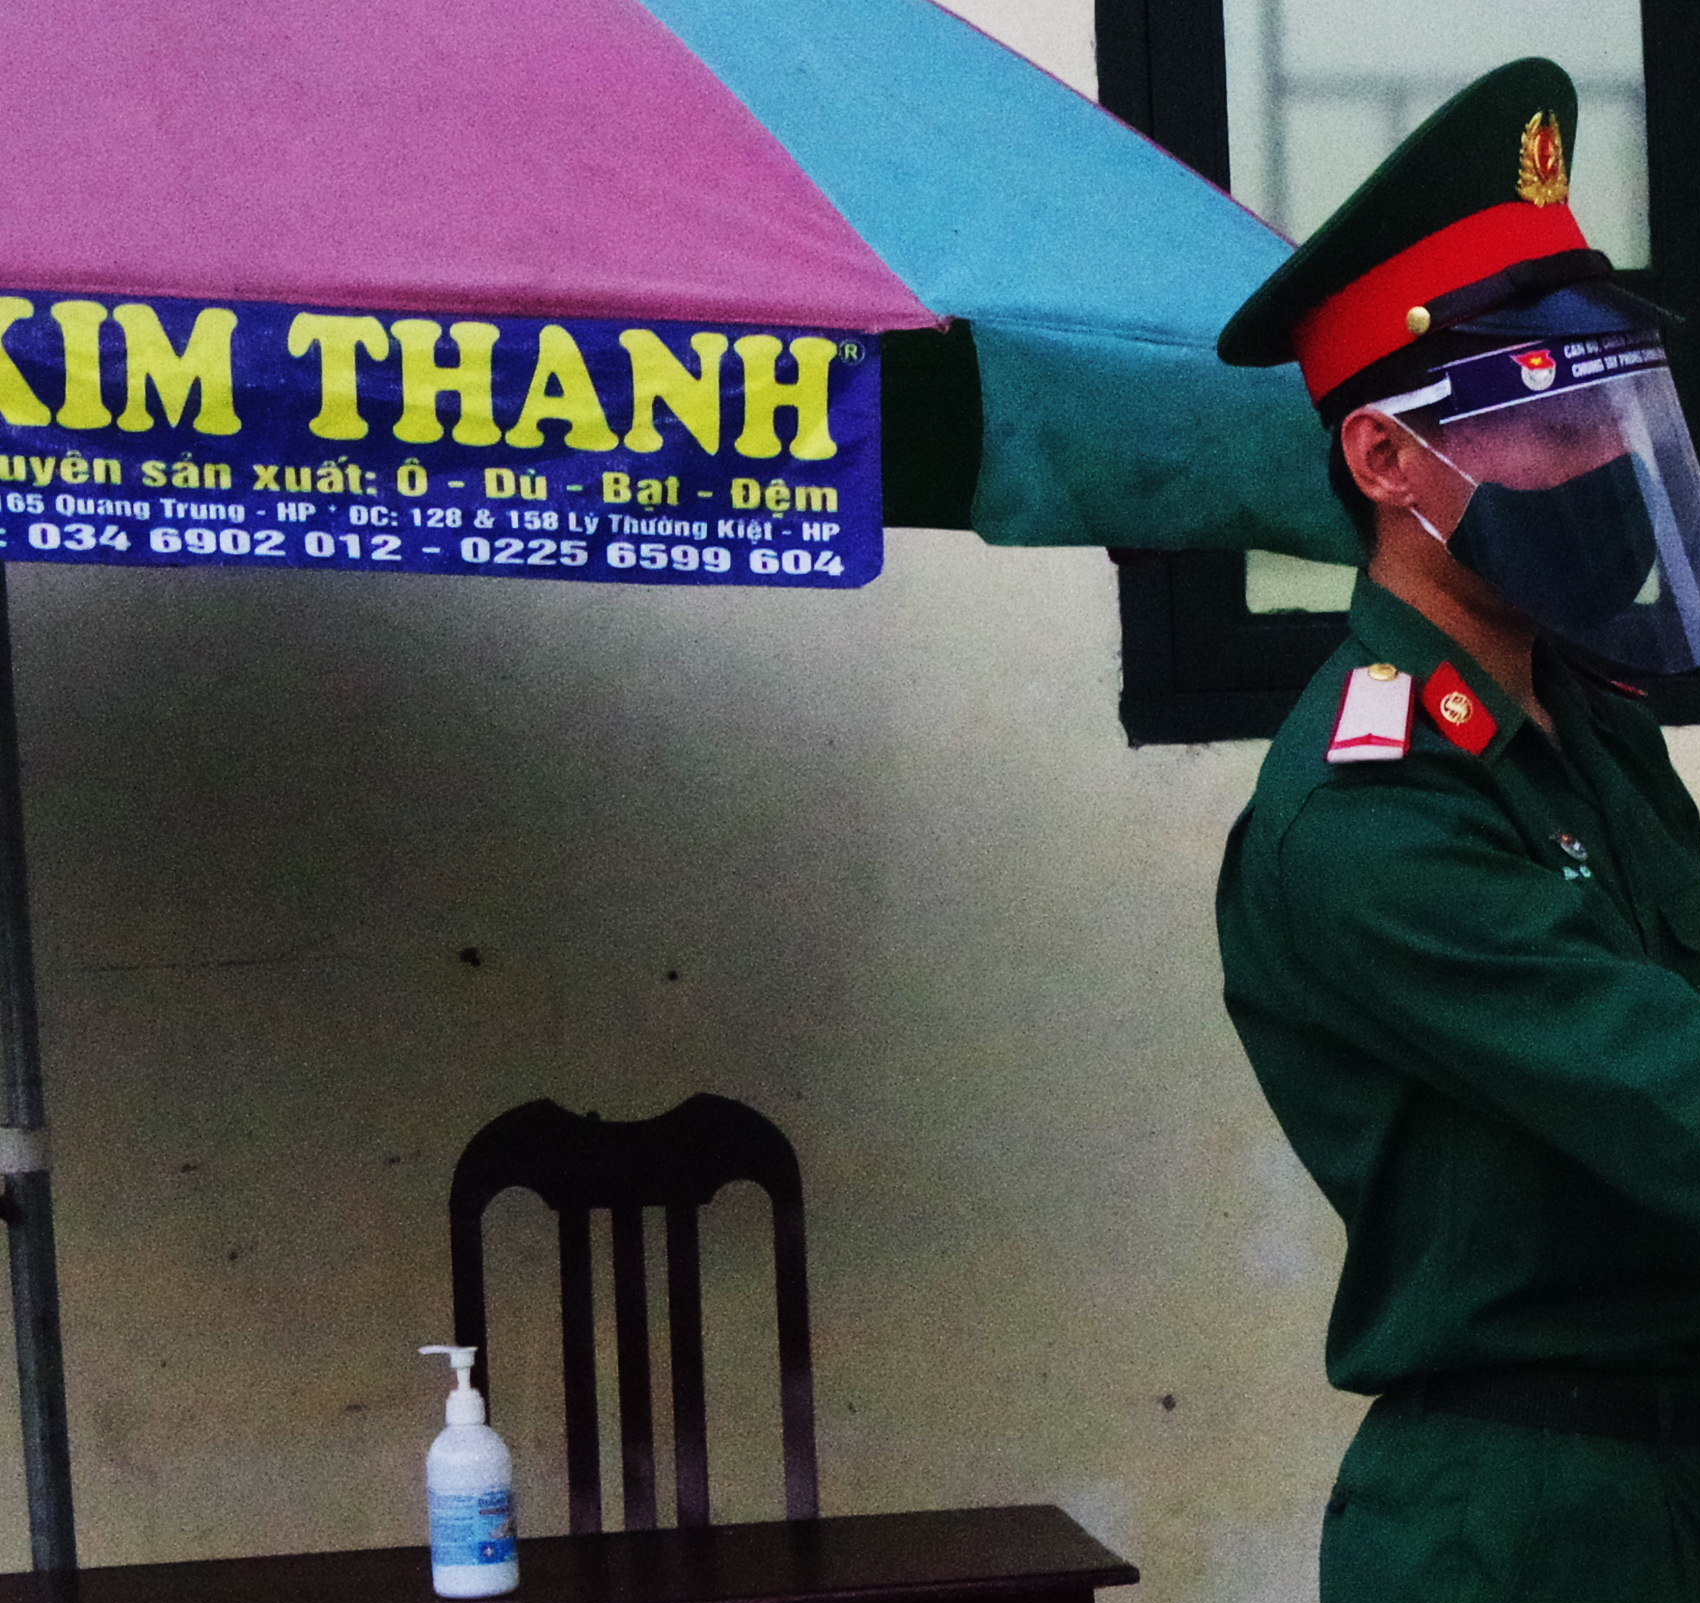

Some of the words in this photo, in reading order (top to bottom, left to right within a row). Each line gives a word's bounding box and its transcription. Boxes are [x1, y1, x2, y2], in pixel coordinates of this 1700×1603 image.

[0, 296, 242, 436] KIM
[287, 311, 838, 461] THANH
[141, 450, 232, 490] sản
[253, 455, 377, 496] xuất:
[396, 457, 429, 497] Ô
[602, 471, 681, 511] Bạt
[729, 478, 838, 519] Đệm
[0, 492, 45, 515] 65
[55, 493, 150, 520] Quang
[159, 498, 246, 524] Trung
[277, 502, 317, 522] HP
[410, 507, 463, 529] 128
[473, 508, 496, 529] &
[506, 510, 559, 531] 158
[802, 522, 841, 542] HP
[28, 522, 132, 551] 034
[150, 526, 287, 556] 6902
[304, 530, 403, 561] 012
[460, 536, 589, 567] 0225
[606, 541, 731, 573] 6599
[749, 548, 845, 577] 604
